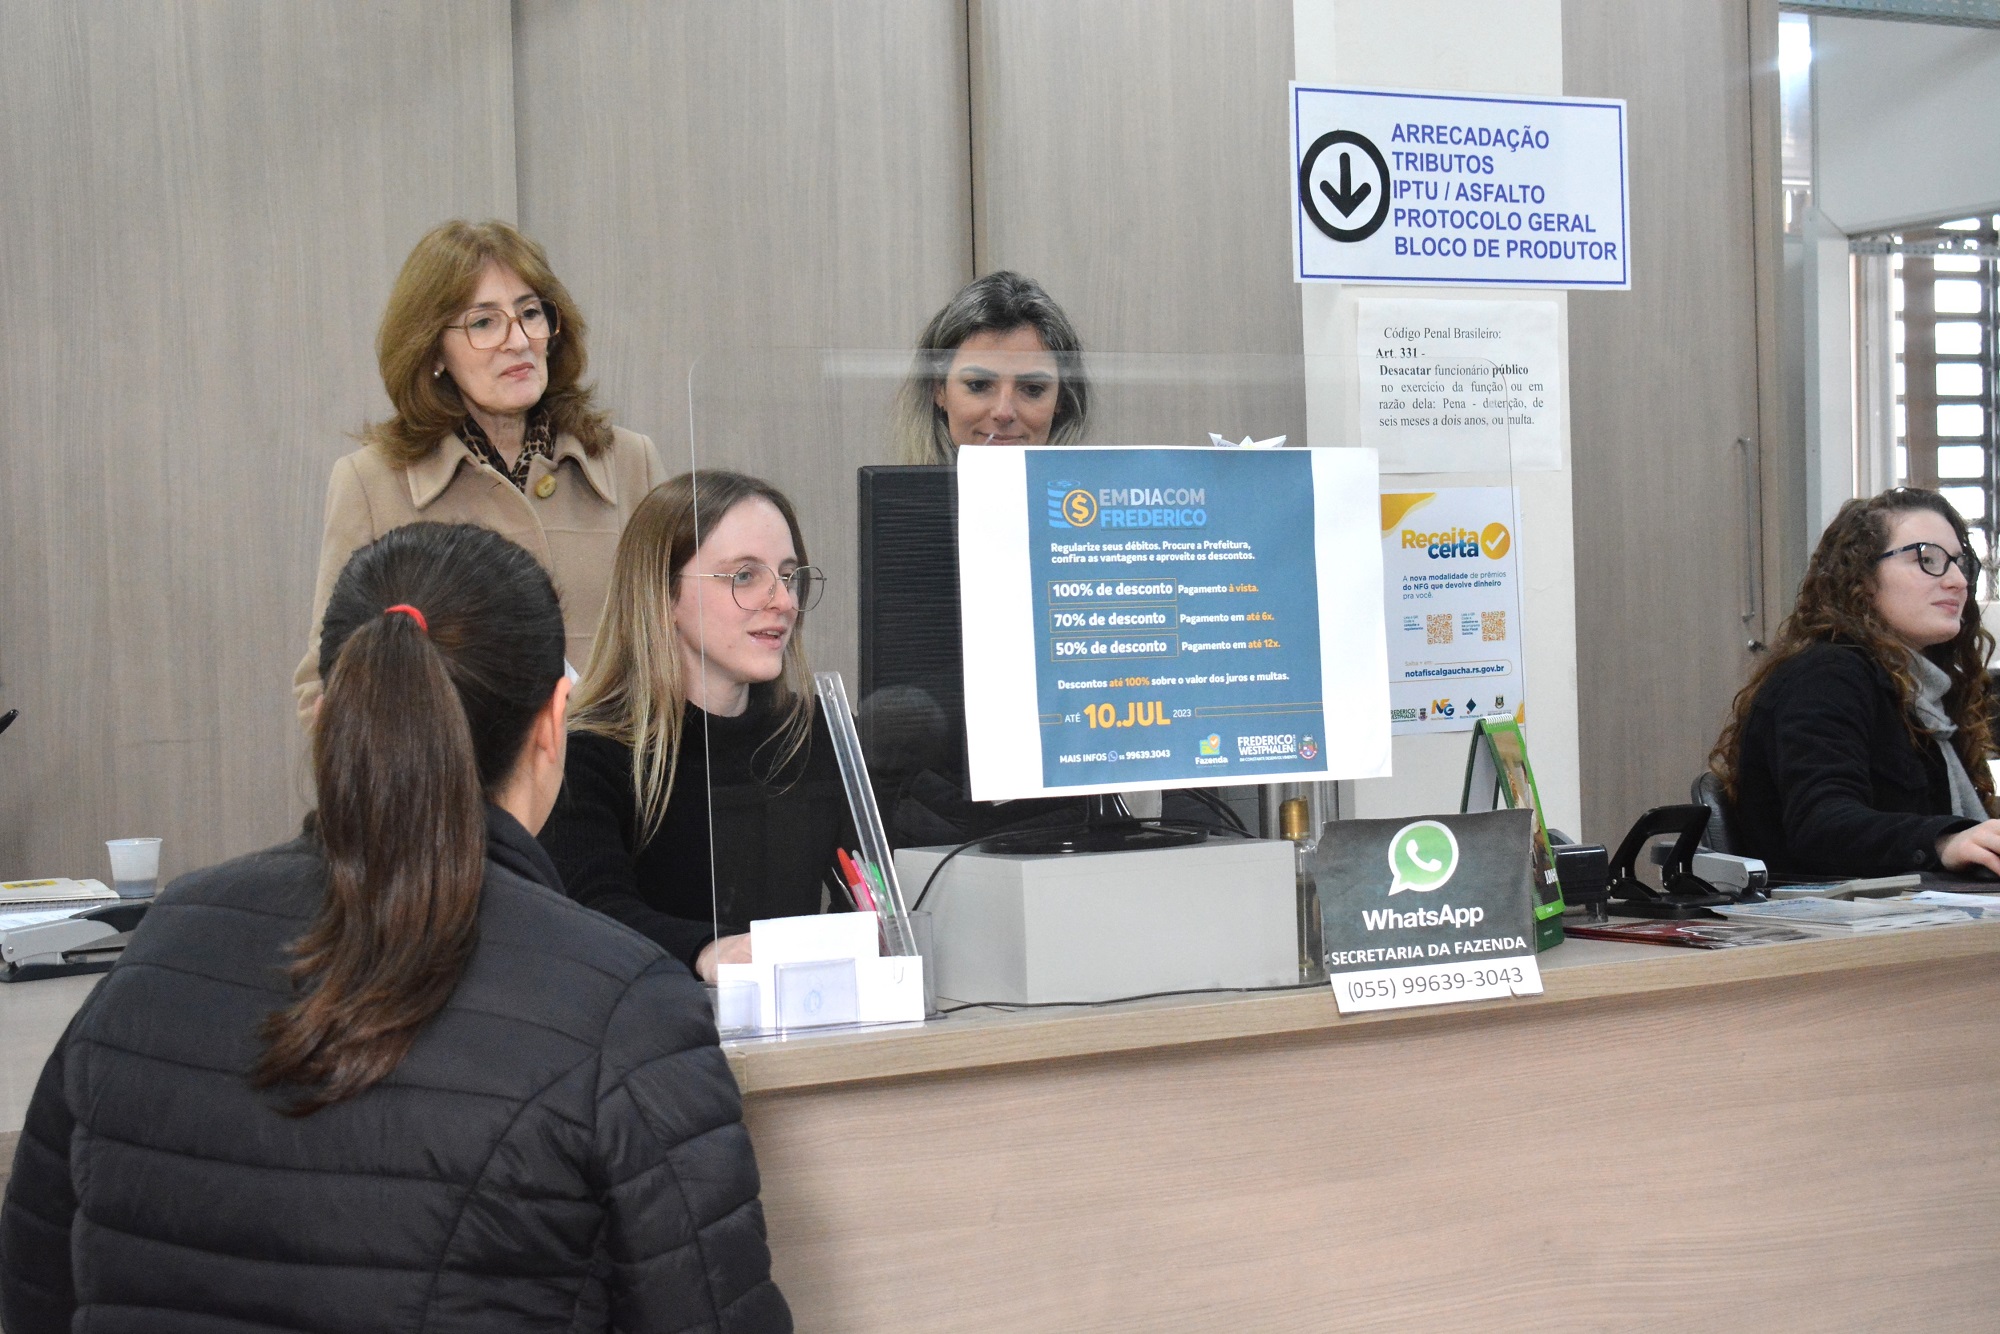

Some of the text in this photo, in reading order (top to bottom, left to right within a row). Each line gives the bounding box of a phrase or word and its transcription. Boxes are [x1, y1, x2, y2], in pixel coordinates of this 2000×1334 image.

[1391, 123, 1550, 152] ARRECADAÇÃO
[1392, 152, 1494, 174] TRIBUTOS
[1393, 180, 1438, 200] IPTU
[1455, 182, 1545, 204] ASFALTO
[1394, 208, 1596, 233] PROTOCOLO GERAL
[1394, 236, 1618, 261] BLOCO DE PRODUTOR
[1384, 327, 1502, 342] Código Penal Brasileiro:
[1376, 348, 1397, 359] Art.
[1400, 348, 1418, 358] 331
[1380, 364, 1529, 378] Desacatar funcionário público
[1381, 381, 1544, 395] no exercício da função ou em
[1379, 398, 1406, 409] razão
[1412, 398, 1436, 409] dela:
[1443, 398, 1466, 409] Pena
[1483, 397, 1527, 411] detenção,
[1533, 397, 1544, 408] de
[1379, 413, 1535, 428] seis meses a dois anos, ou multa.
[1100, 508, 1207, 528] FREDERICO
[1401, 527, 1479, 549] Receita
[1051, 542, 1100, 554] Regularize
[1102, 543, 1123, 551] seus
[1125, 541, 1161, 551] débitos.
[1162, 541, 1195, 550] Procure
[1203, 540, 1251, 551] Prefeitura,
[1427, 539, 1479, 559] certa
[1052, 553, 1086, 564] confira
[1088, 555, 1098, 563] as
[1100, 553, 1147, 564] vantagens
[1149, 554, 1154, 562] e
[1156, 552, 1195, 563] aproveite
[1208, 551, 1255, 560] descontos.
[1428, 573, 1468, 581] modalidade
[1480, 571, 1506, 581] prêmios
[1053, 582, 1173, 597] 100% de desconto
[1178, 584, 1227, 596] Pagamento
[1236, 583, 1259, 593] vista.
[1431, 583, 1443, 592] que
[1445, 581, 1472, 589] devolve
[1474, 580, 1502, 588] dinheiro
[1416, 591, 1433, 599] você.
[1054, 612, 1166, 627] 70% de desconto
[1180, 614, 1229, 625] Pagamento
[1246, 612, 1260, 621] até
[1261, 612, 1275, 620] 6x.
[1056, 640, 1167, 656] 50% de desconto
[1182, 641, 1231, 653] Pagamento
[1248, 640, 1262, 648] até
[1264, 639, 1280, 648] 12x.
[1405, 665, 1505, 678] notafiscalgaucha.rs.gov.br
[1058, 679, 1107, 690] Descontos
[1109, 678, 1124, 688] até
[1125, 677, 1150, 687] 100%
[1151, 676, 1176, 686] sobre
[1186, 675, 1207, 684] valor
[1209, 674, 1224, 683] dos
[1226, 673, 1248, 684] juros
[1257, 672, 1289, 681] multas.
[1065, 701, 1192, 729] ATÉ 10.JUL 2023
[1237, 734, 1293, 746] FREDERICO
[1060, 754, 1081, 763] MAIS
[1083, 753, 1107, 762] INFOS
[1126, 750, 1170, 760] 99639.3043
[1239, 744, 1293, 755] WESTPHALEN
[1195, 755, 1229, 765] Fazenda
[1362, 904, 1484, 931] WhatsApp
[1331, 936, 1527, 966] SECRETARIA DA FAZENDA
[1348, 967, 1524, 1002] (055) 99639-3043
